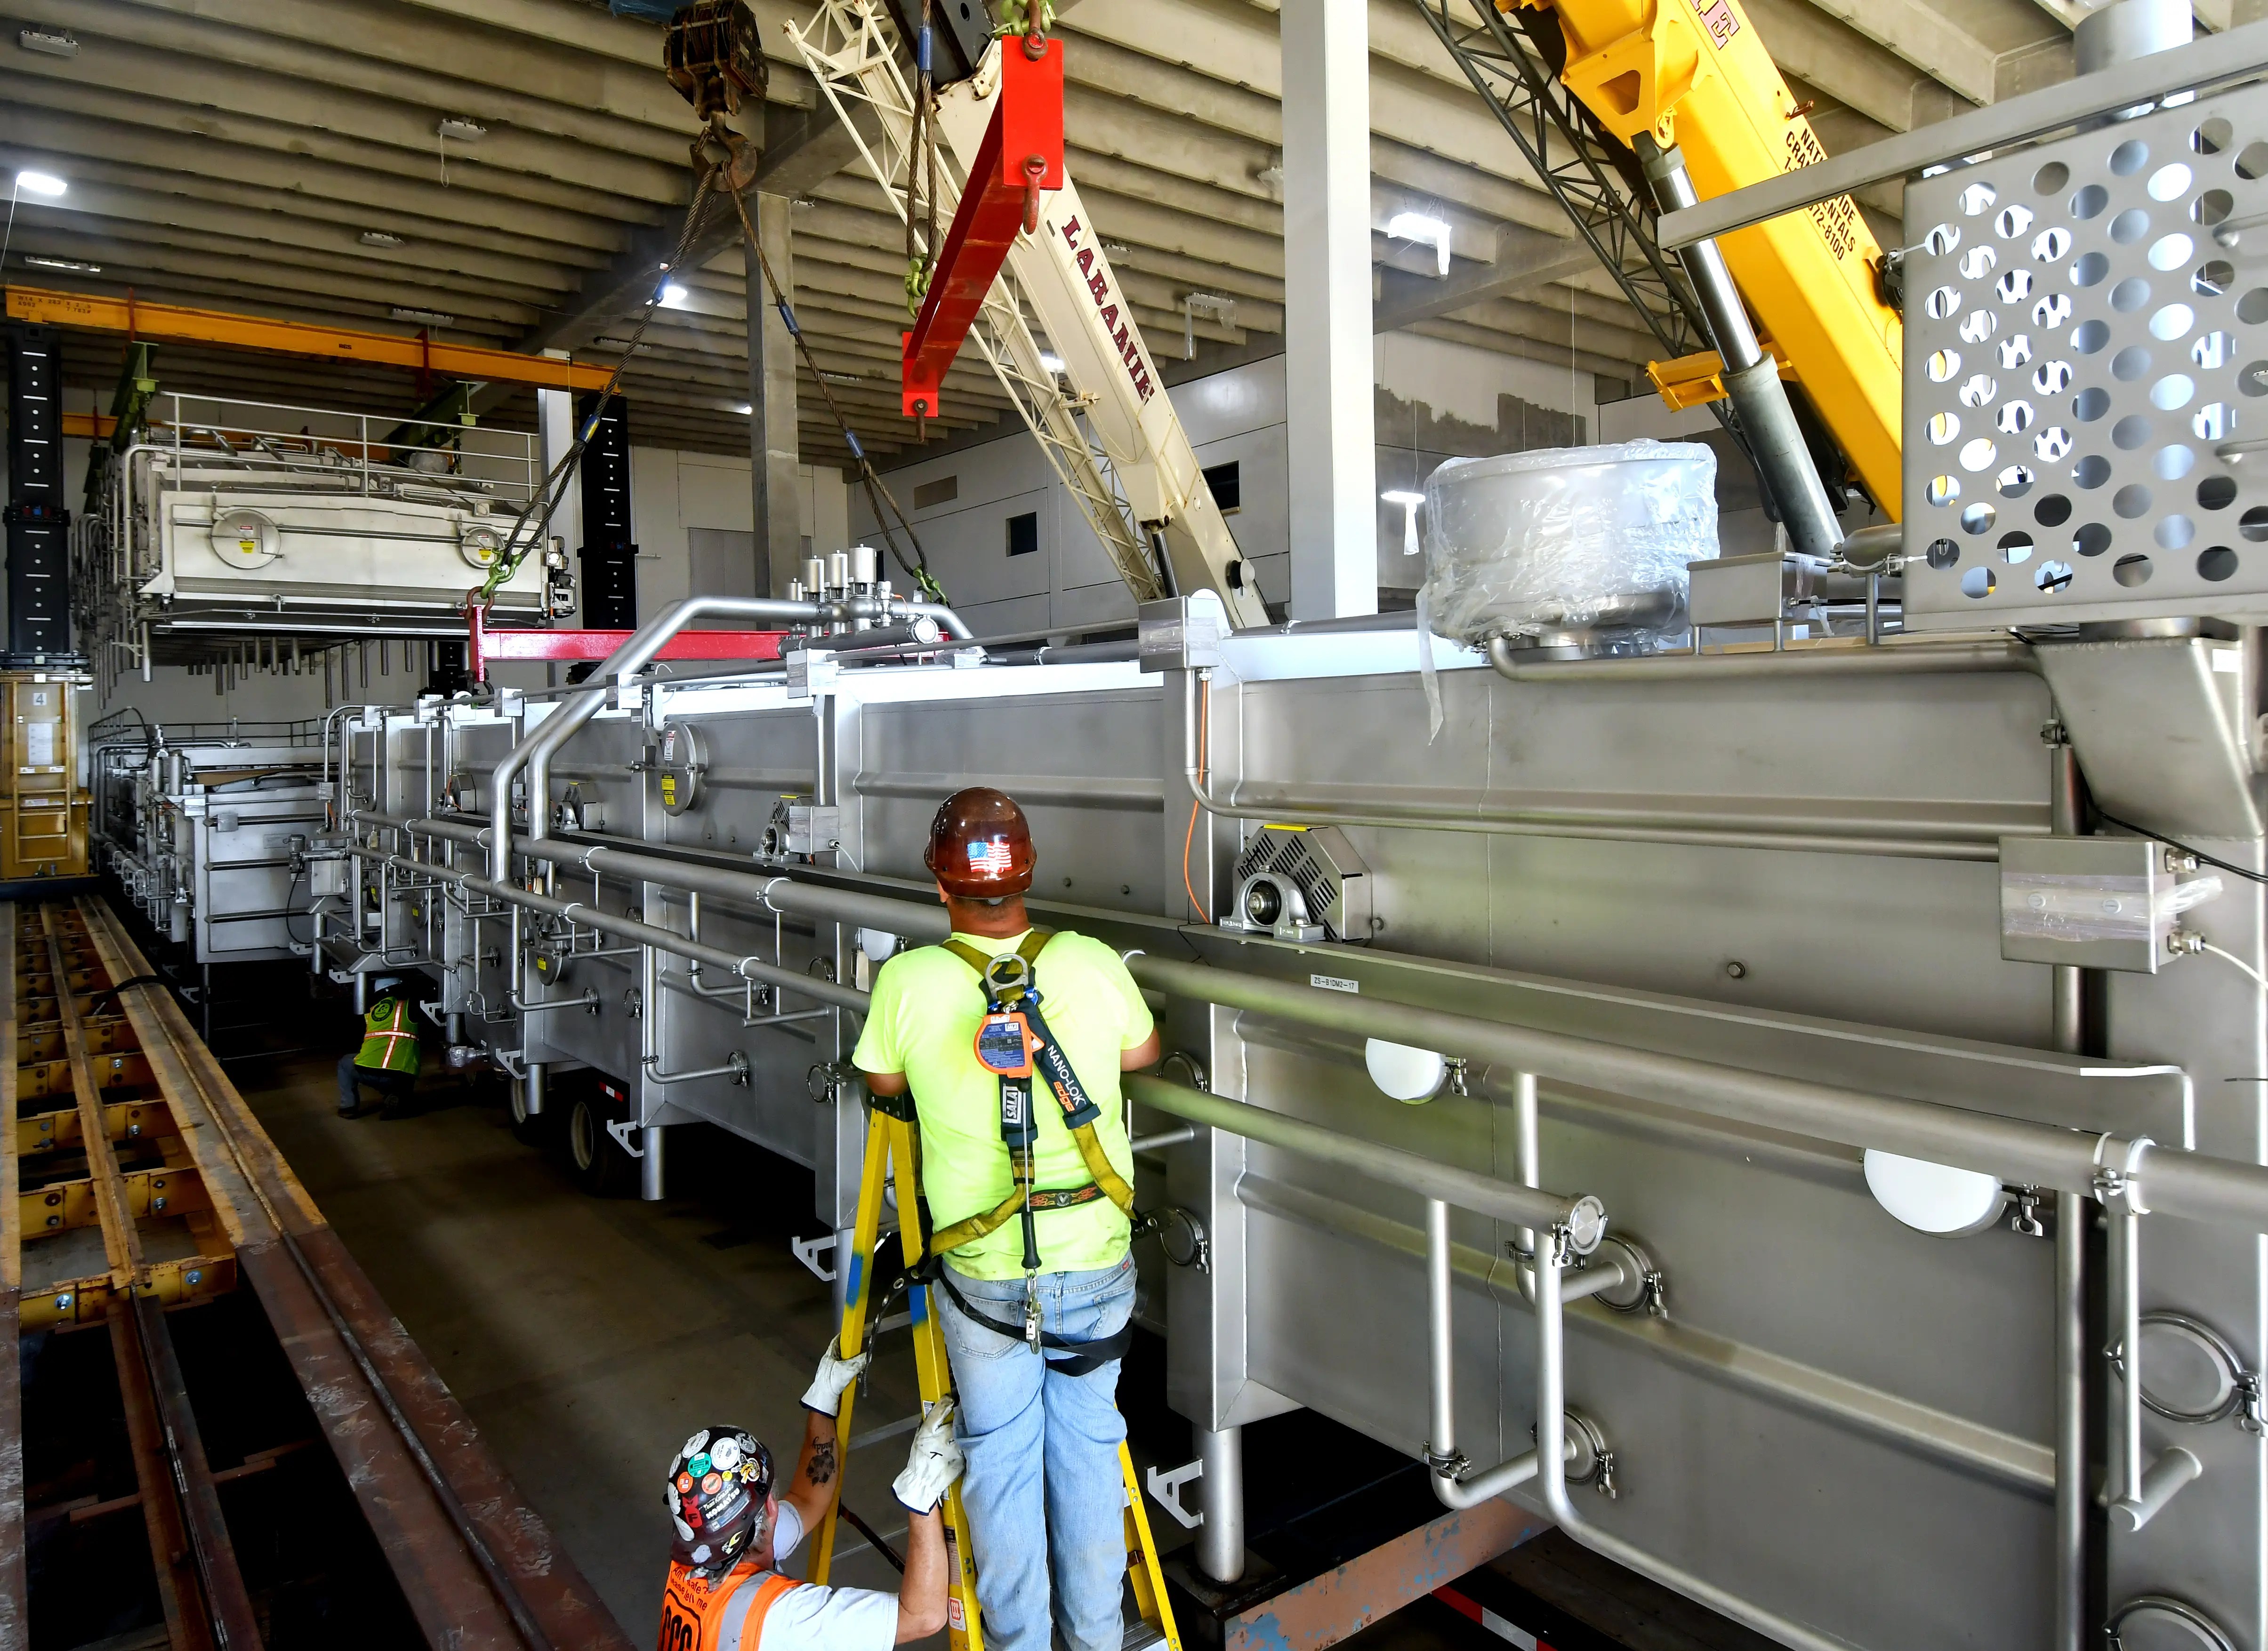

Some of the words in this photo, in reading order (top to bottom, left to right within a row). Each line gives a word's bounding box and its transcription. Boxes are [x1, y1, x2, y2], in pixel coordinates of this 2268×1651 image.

[1061, 215, 1155, 406] LARAMIE
[36, 694, 43, 705] 4
[1006, 1092, 1018, 1119] SALA
[1054, 1081, 1076, 1112] edge
[706, 1487, 740, 1519] KOMATSU
[687, 1579, 701, 1594] safe
[697, 1598, 708, 1611] me
